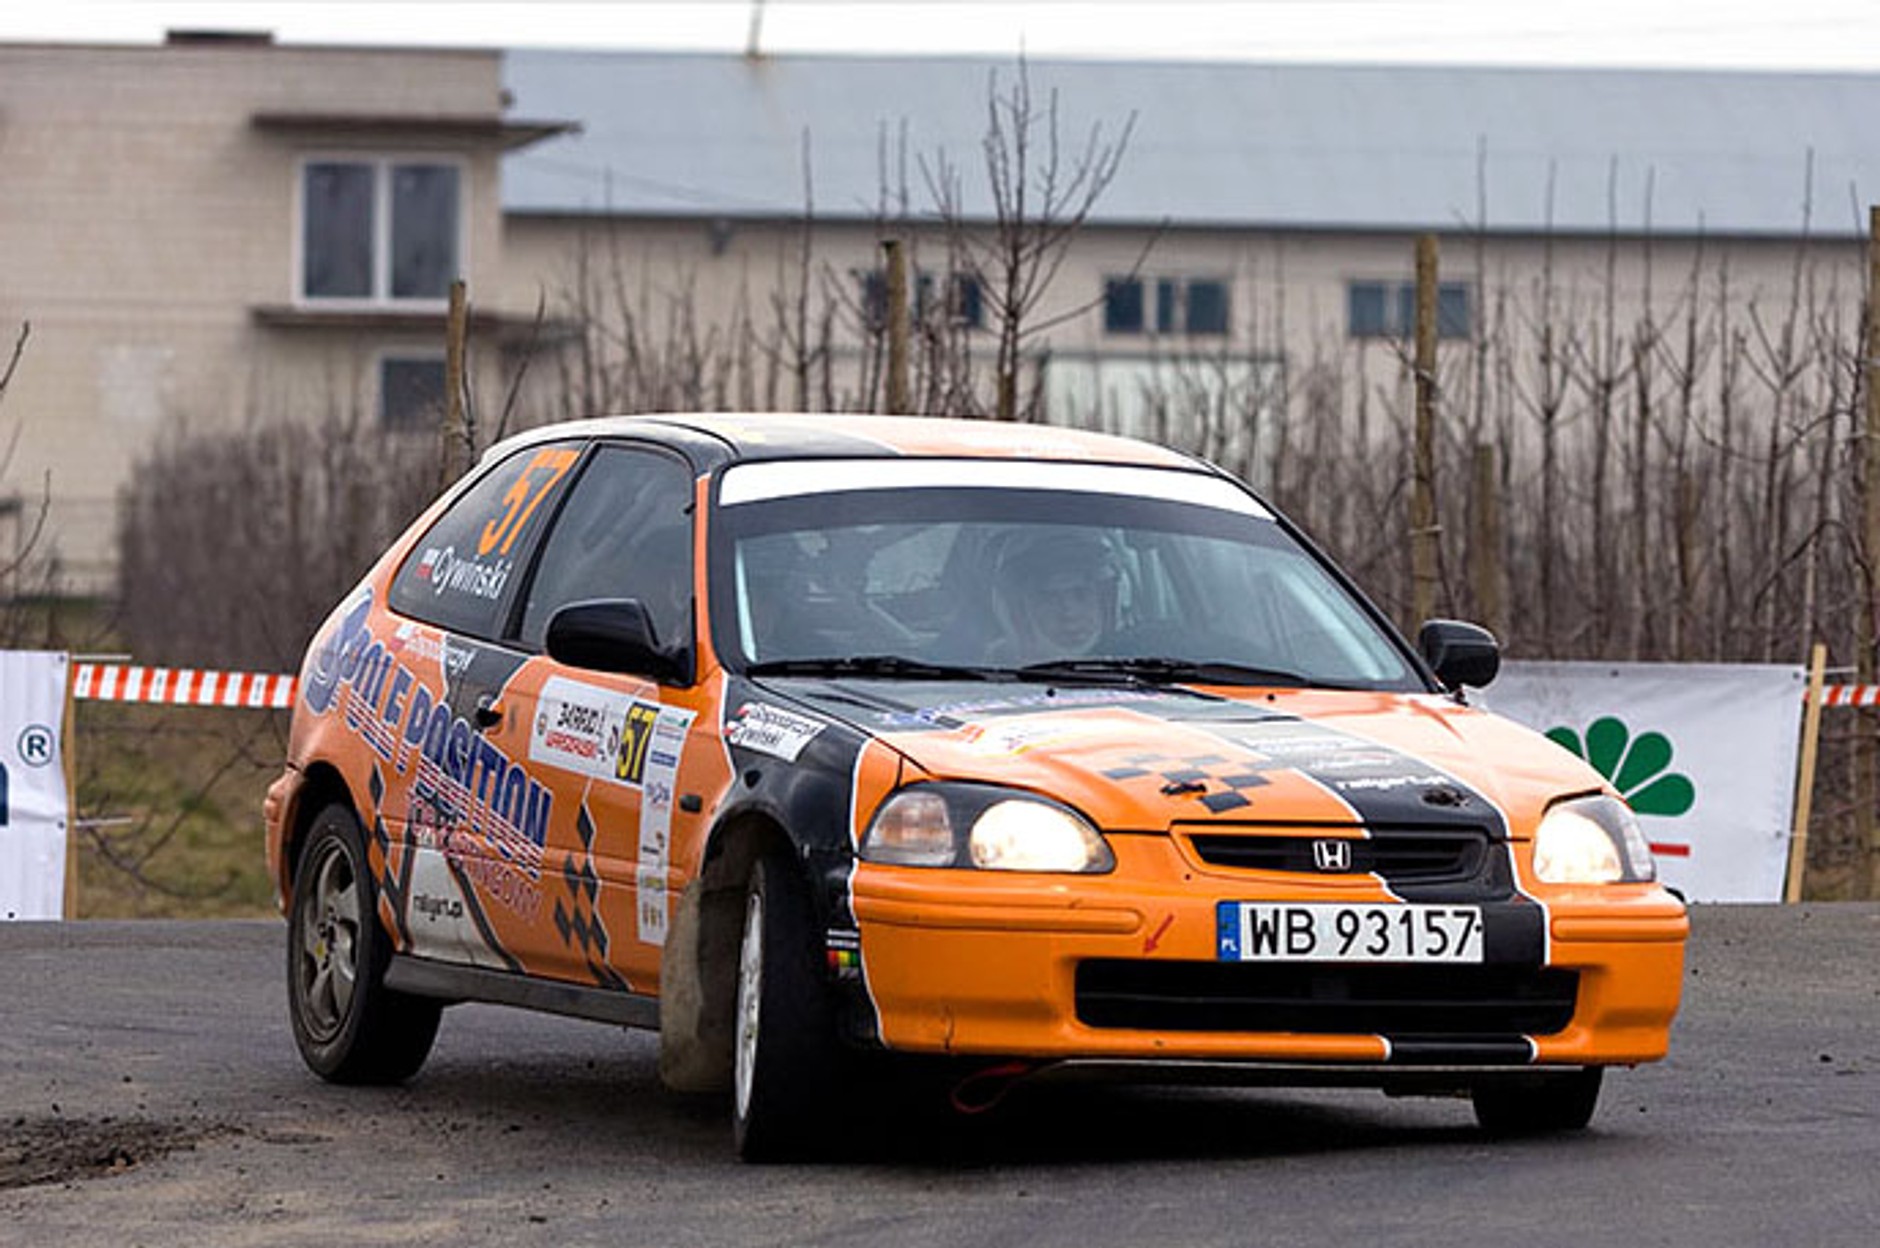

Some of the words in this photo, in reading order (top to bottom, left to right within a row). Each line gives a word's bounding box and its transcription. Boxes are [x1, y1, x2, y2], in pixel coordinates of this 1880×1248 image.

[477, 448, 582, 556] 57
[403, 680, 555, 852] POSITION
[617, 705, 658, 780] 57
[1249, 908, 1317, 955] WB
[1334, 908, 1477, 956] 93157
